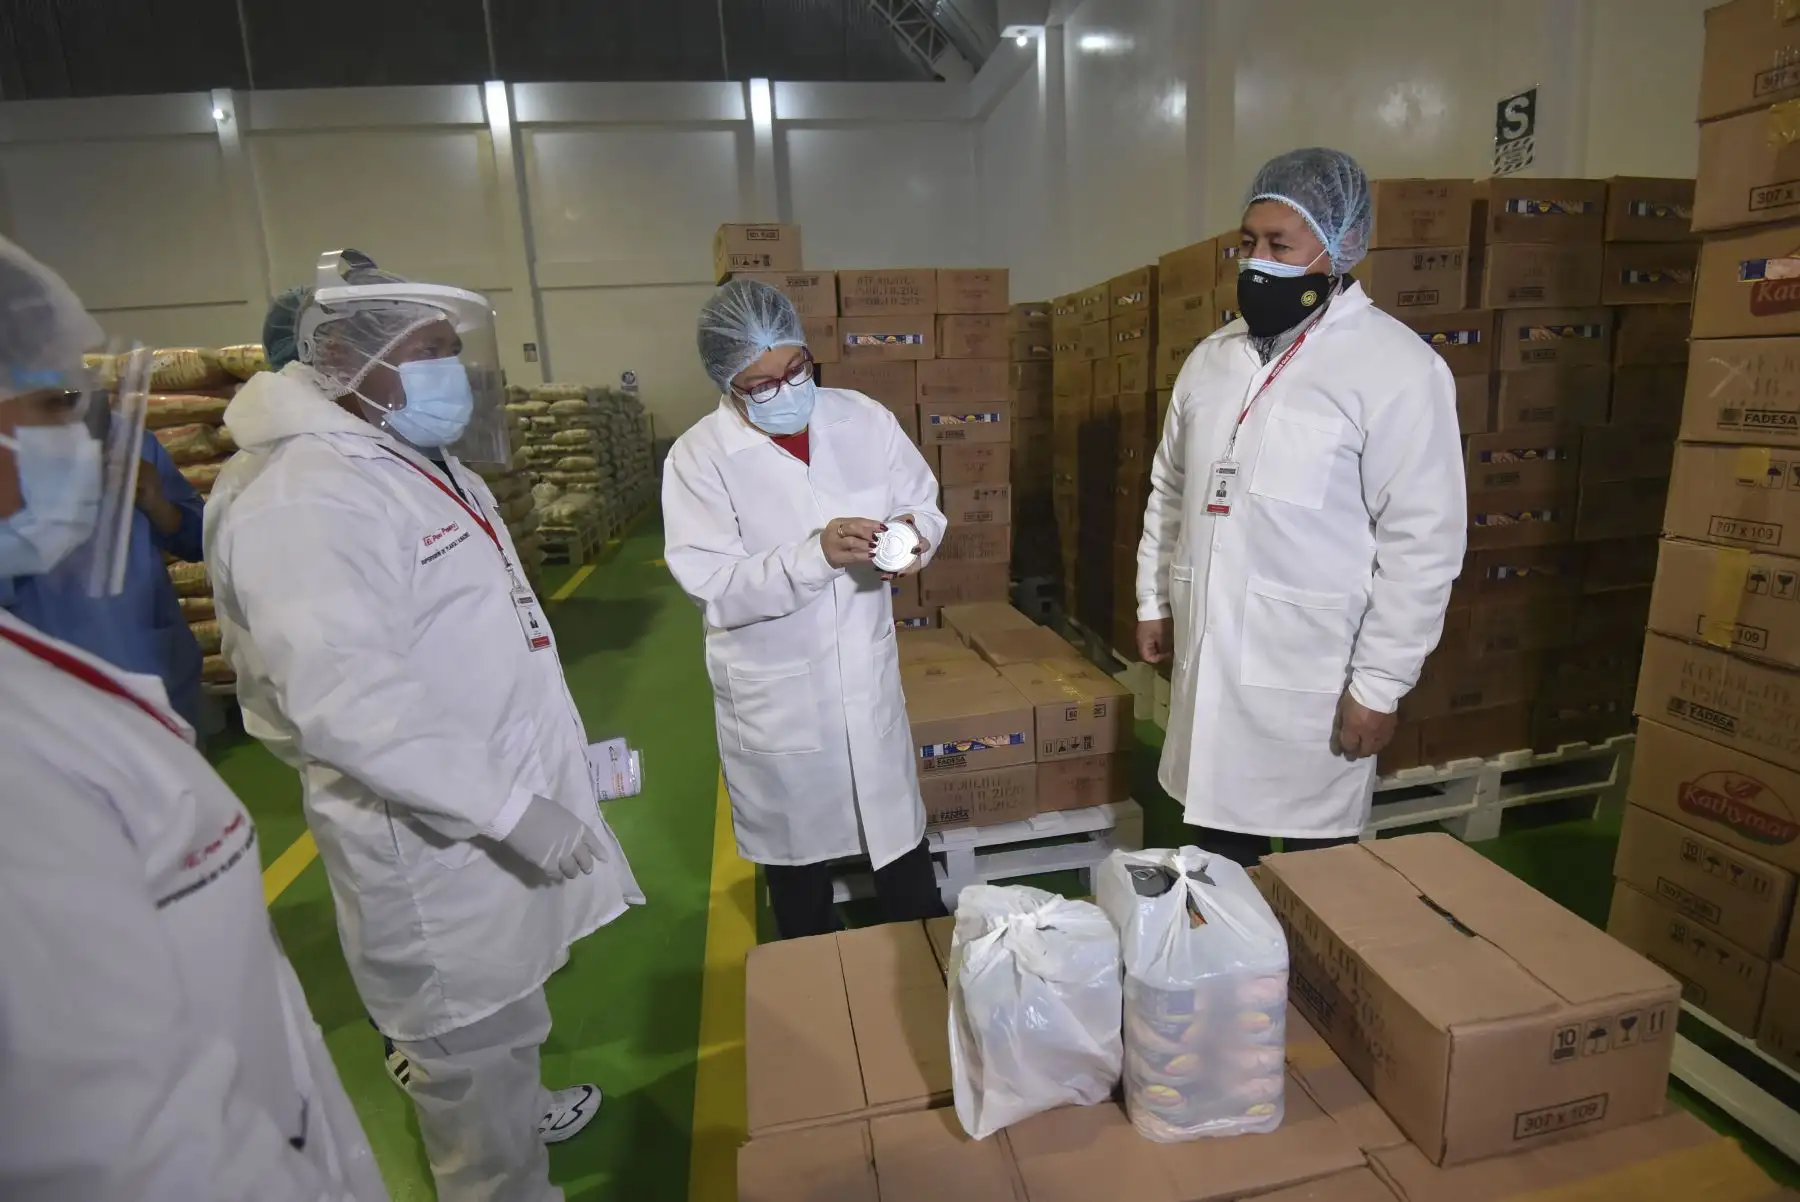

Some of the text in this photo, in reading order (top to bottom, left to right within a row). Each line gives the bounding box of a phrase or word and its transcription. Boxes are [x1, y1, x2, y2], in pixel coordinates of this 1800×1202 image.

[1503, 96, 1530, 140] S
[1757, 189, 1782, 204] 307
[1744, 413, 1798, 426] FADESA
[1751, 527, 1774, 540] 109
[1739, 628, 1760, 643] 109
[1689, 706, 1735, 729] FADESA
[1685, 841, 1699, 856] 10
[1672, 923, 1686, 937] 10
[1557, 1028, 1577, 1047] 10
[1523, 1102, 1598, 1133] 307 x 109
